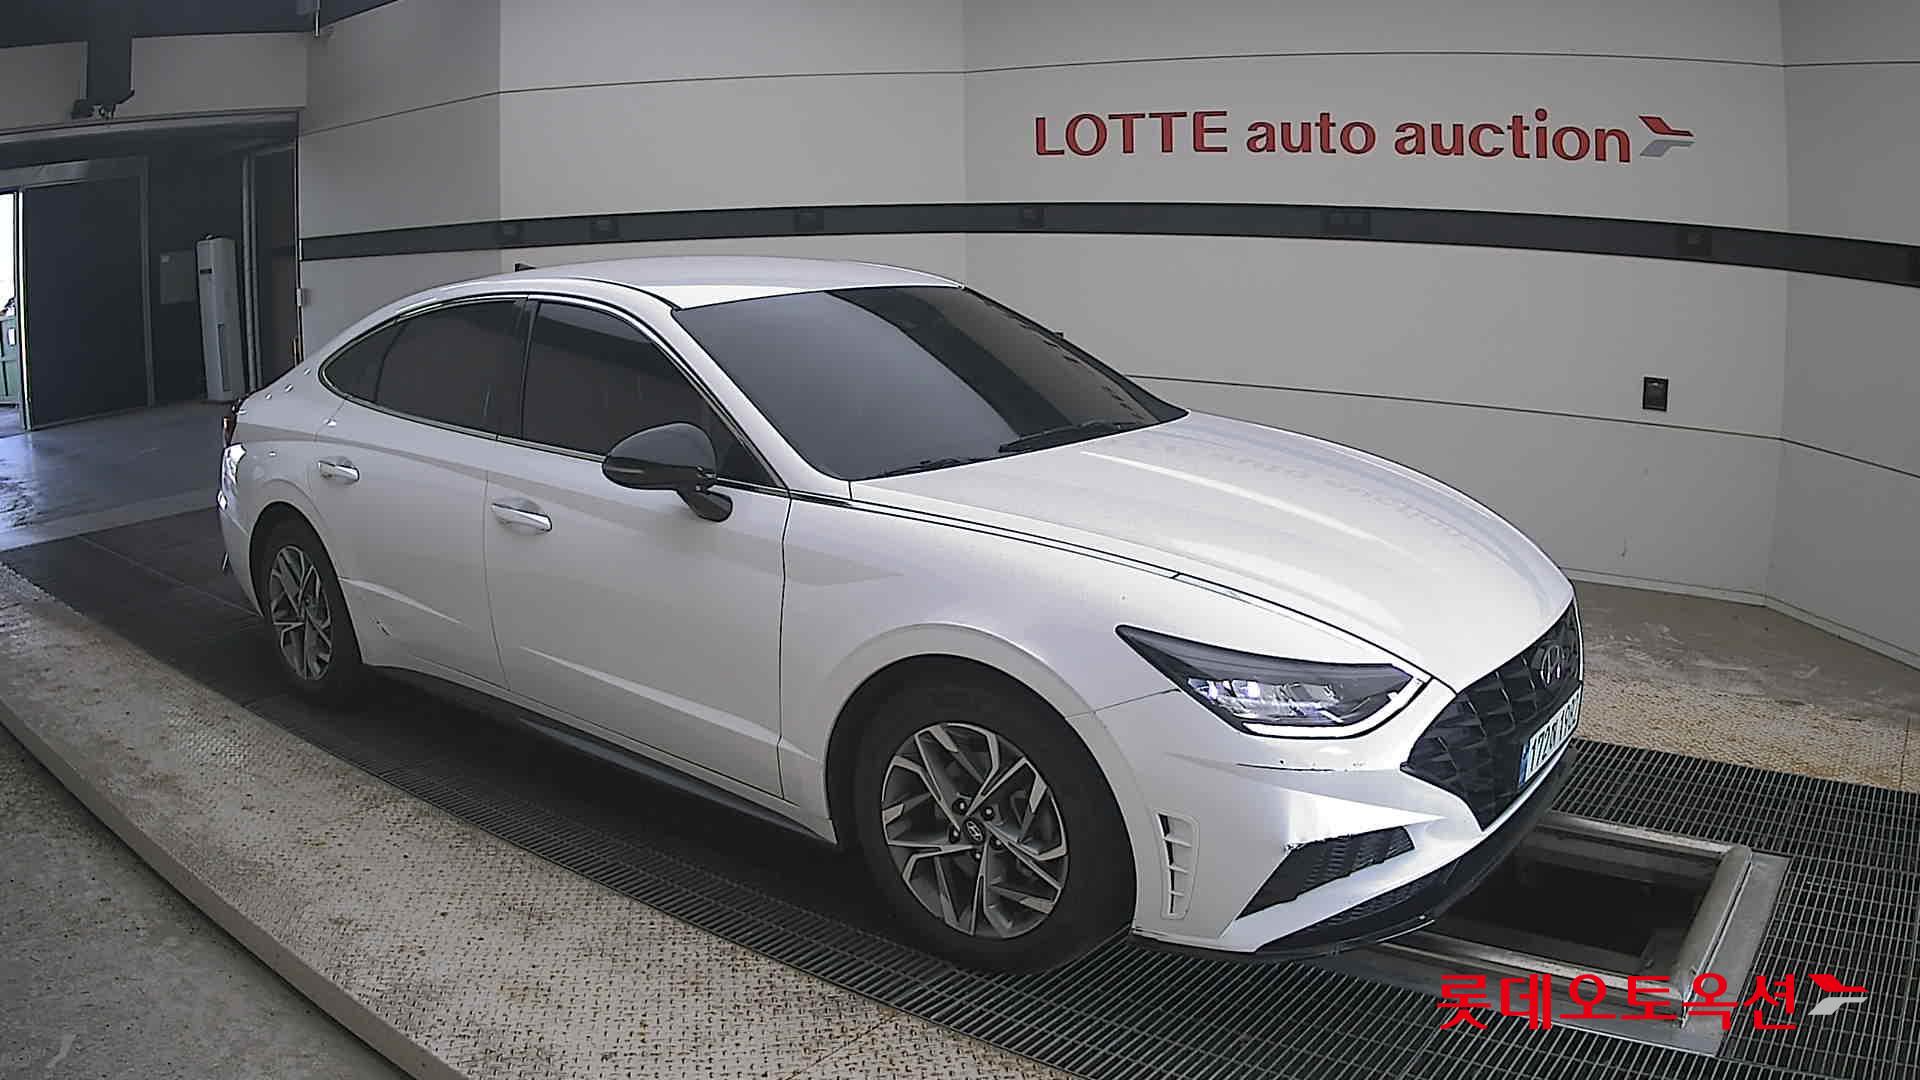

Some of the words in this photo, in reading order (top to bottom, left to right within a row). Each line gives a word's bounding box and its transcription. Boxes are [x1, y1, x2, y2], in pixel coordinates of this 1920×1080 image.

[1036, 111, 1229, 156] LOTTE
[1246, 113, 1376, 154] auto
[1395, 109, 1632, 163] auction
